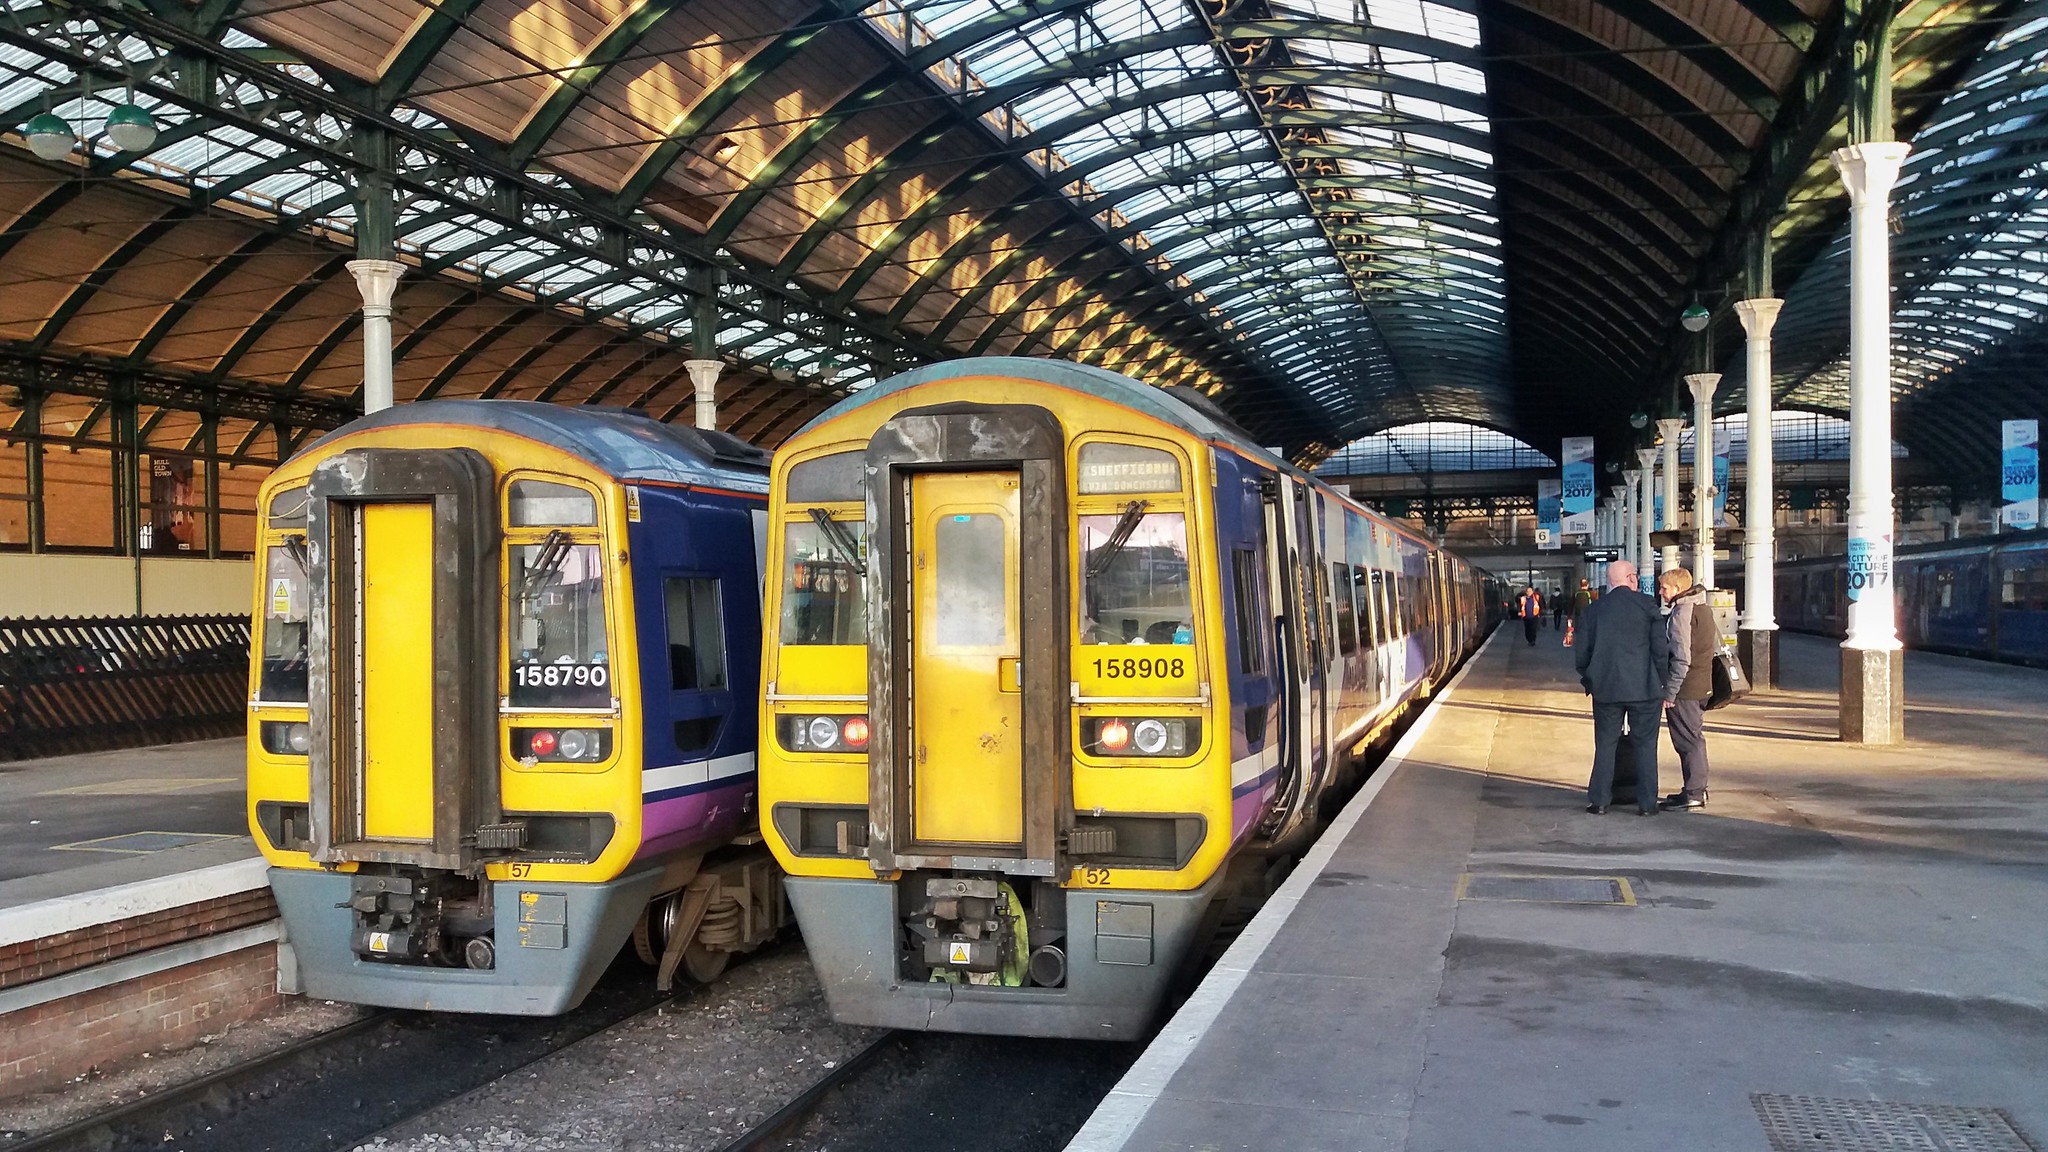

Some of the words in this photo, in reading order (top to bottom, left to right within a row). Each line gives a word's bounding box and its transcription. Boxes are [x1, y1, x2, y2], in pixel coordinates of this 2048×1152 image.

[2005, 475, 2036, 485] 2017
[1564, 488, 1593, 498] 2017
[1540, 516, 1560, 524] 2017
[1539, 531, 1547, 541] 6
[1852, 554, 1873, 562] CITY
[1875, 554, 1888, 562] OF
[1848, 562, 1888, 571] ULTURE
[1092, 658, 1185, 679] 158908
[515, 665, 607, 687] 158790
[511, 863, 532, 878] 57
[1087, 869, 1110, 885] 52
